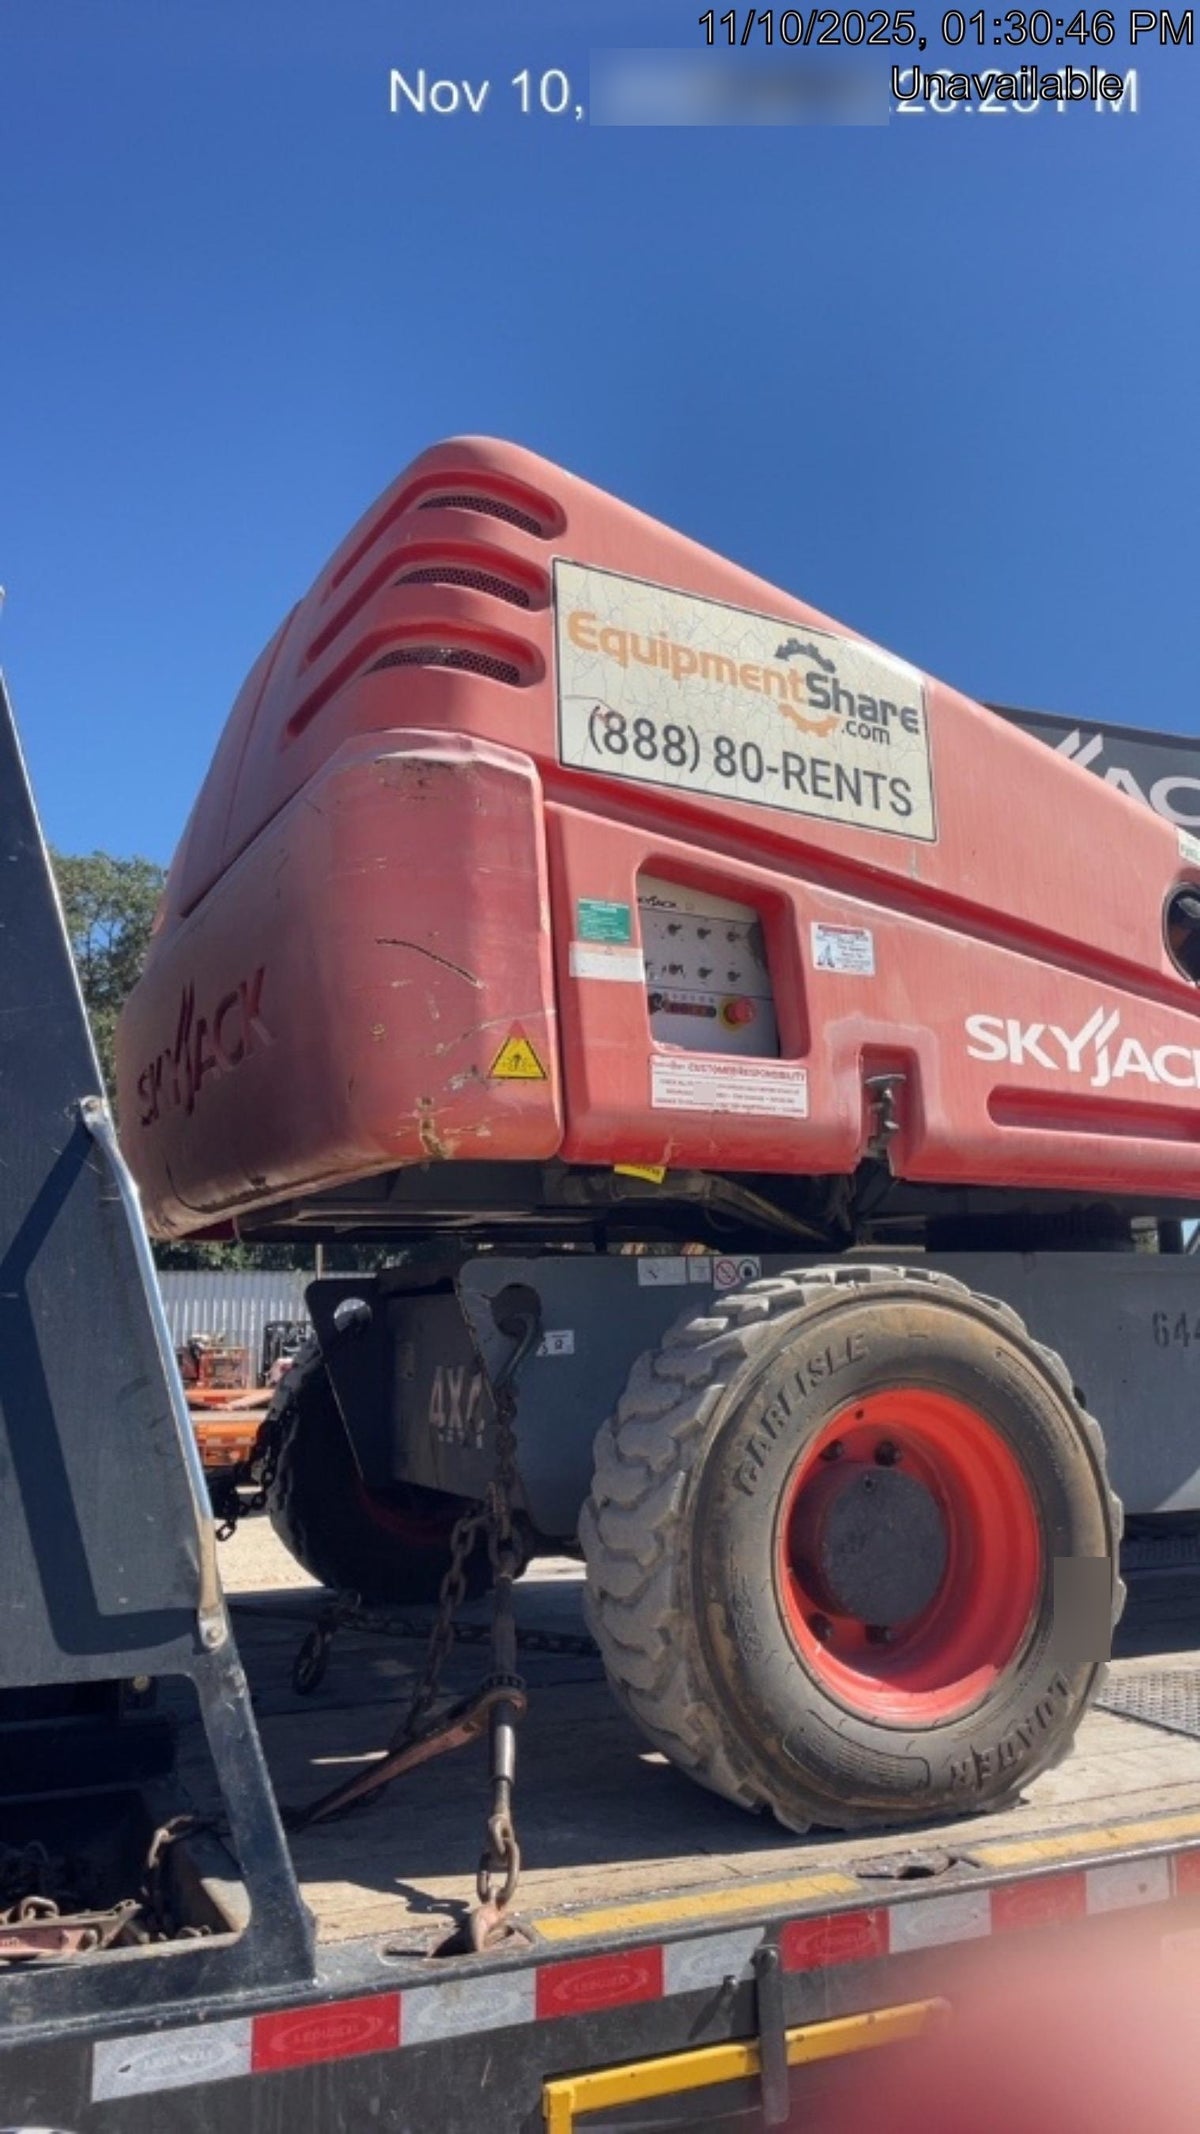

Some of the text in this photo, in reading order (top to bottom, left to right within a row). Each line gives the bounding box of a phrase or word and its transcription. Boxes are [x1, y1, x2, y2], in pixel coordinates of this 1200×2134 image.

[566, 611, 920, 735] EquipmentShare
[589, 705, 914, 817] (888) 80-RENTS
[841, 721, 891, 746] .com
[965, 1006, 1200, 1088] SKYJAC
